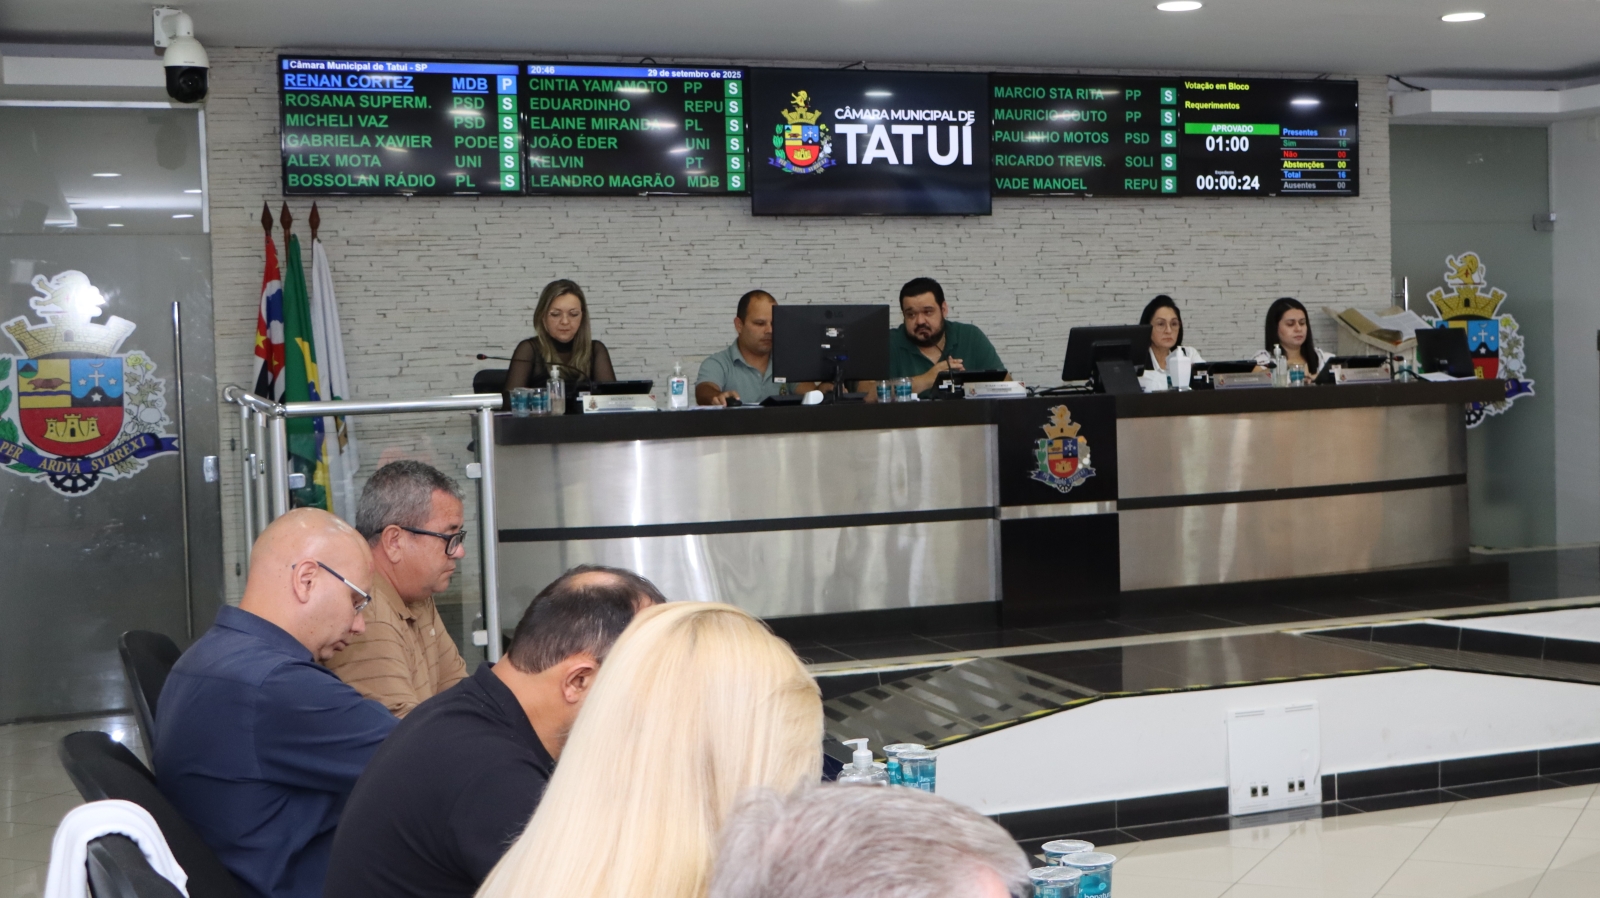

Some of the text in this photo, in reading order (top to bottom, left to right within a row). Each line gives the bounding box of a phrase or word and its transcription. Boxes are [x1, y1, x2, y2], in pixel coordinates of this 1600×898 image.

[290, 60, 325, 71] Câmara
[327, 61, 370, 71] Municipal
[373, 62, 384, 70] de
[415, 63, 428, 71] SP
[531, 66, 555, 74] 20:46
[647, 69, 657, 77] 29
[659, 69, 670, 77] de
[671, 70, 709, 78] setembro
[711, 70, 720, 78] de
[285, 74, 512, 90] RENAN CORTEZ MDB P
[529, 79, 738, 94] CINTIA YAMAMOTO PP S
[1185, 82, 1214, 90] Votação
[1228, 82, 1249, 90] Bloco
[994, 87, 1172, 101] MARCIO STA RITA PP S
[285, 94, 512, 110] ROSANA SUPERM. PSD S
[530, 98, 739, 113] EDUARDINHO REPU S
[1185, 101, 1240, 110] Requerimentos
[835, 106, 975, 121] CÂMARA MUNICIPAL DE
[995, 109, 1172, 123] MAURICIO COUTO PP S
[286, 114, 513, 129] MICHELI VAZ PSD S
[531, 117, 739, 132] ELAINE MIRANDA PL S
[1211, 124, 1253, 132] APROVADO
[995, 131, 1172, 144] PAULINHO MOTOS PSD S
[1283, 128, 1318, 136] Presentes
[287, 134, 514, 149] GABRIELA XAVIER PODE S
[531, 133, 740, 150] JOÃO ÉDER UNI S
[835, 119, 975, 165] TATUÍ
[1206, 136, 1249, 151] 01:00
[287, 154, 514, 168] ALEX MOTA UNI S
[531, 155, 740, 169] KELVIN PT S
[995, 155, 1173, 168] RICARDO TREVIS. SOLI S
[1283, 161, 1324, 169] Abstenções
[288, 171, 515, 188] BOSSOLAN RÁDIO PL S
[531, 172, 741, 188] LEANDRO MAGRÃO MDB S
[995, 178, 1173, 190] VADE MANOEL REPU S
[1196, 175, 1260, 190] 00:00:24
[0, 436, 147, 474] PER ARDVA SVRREXI
